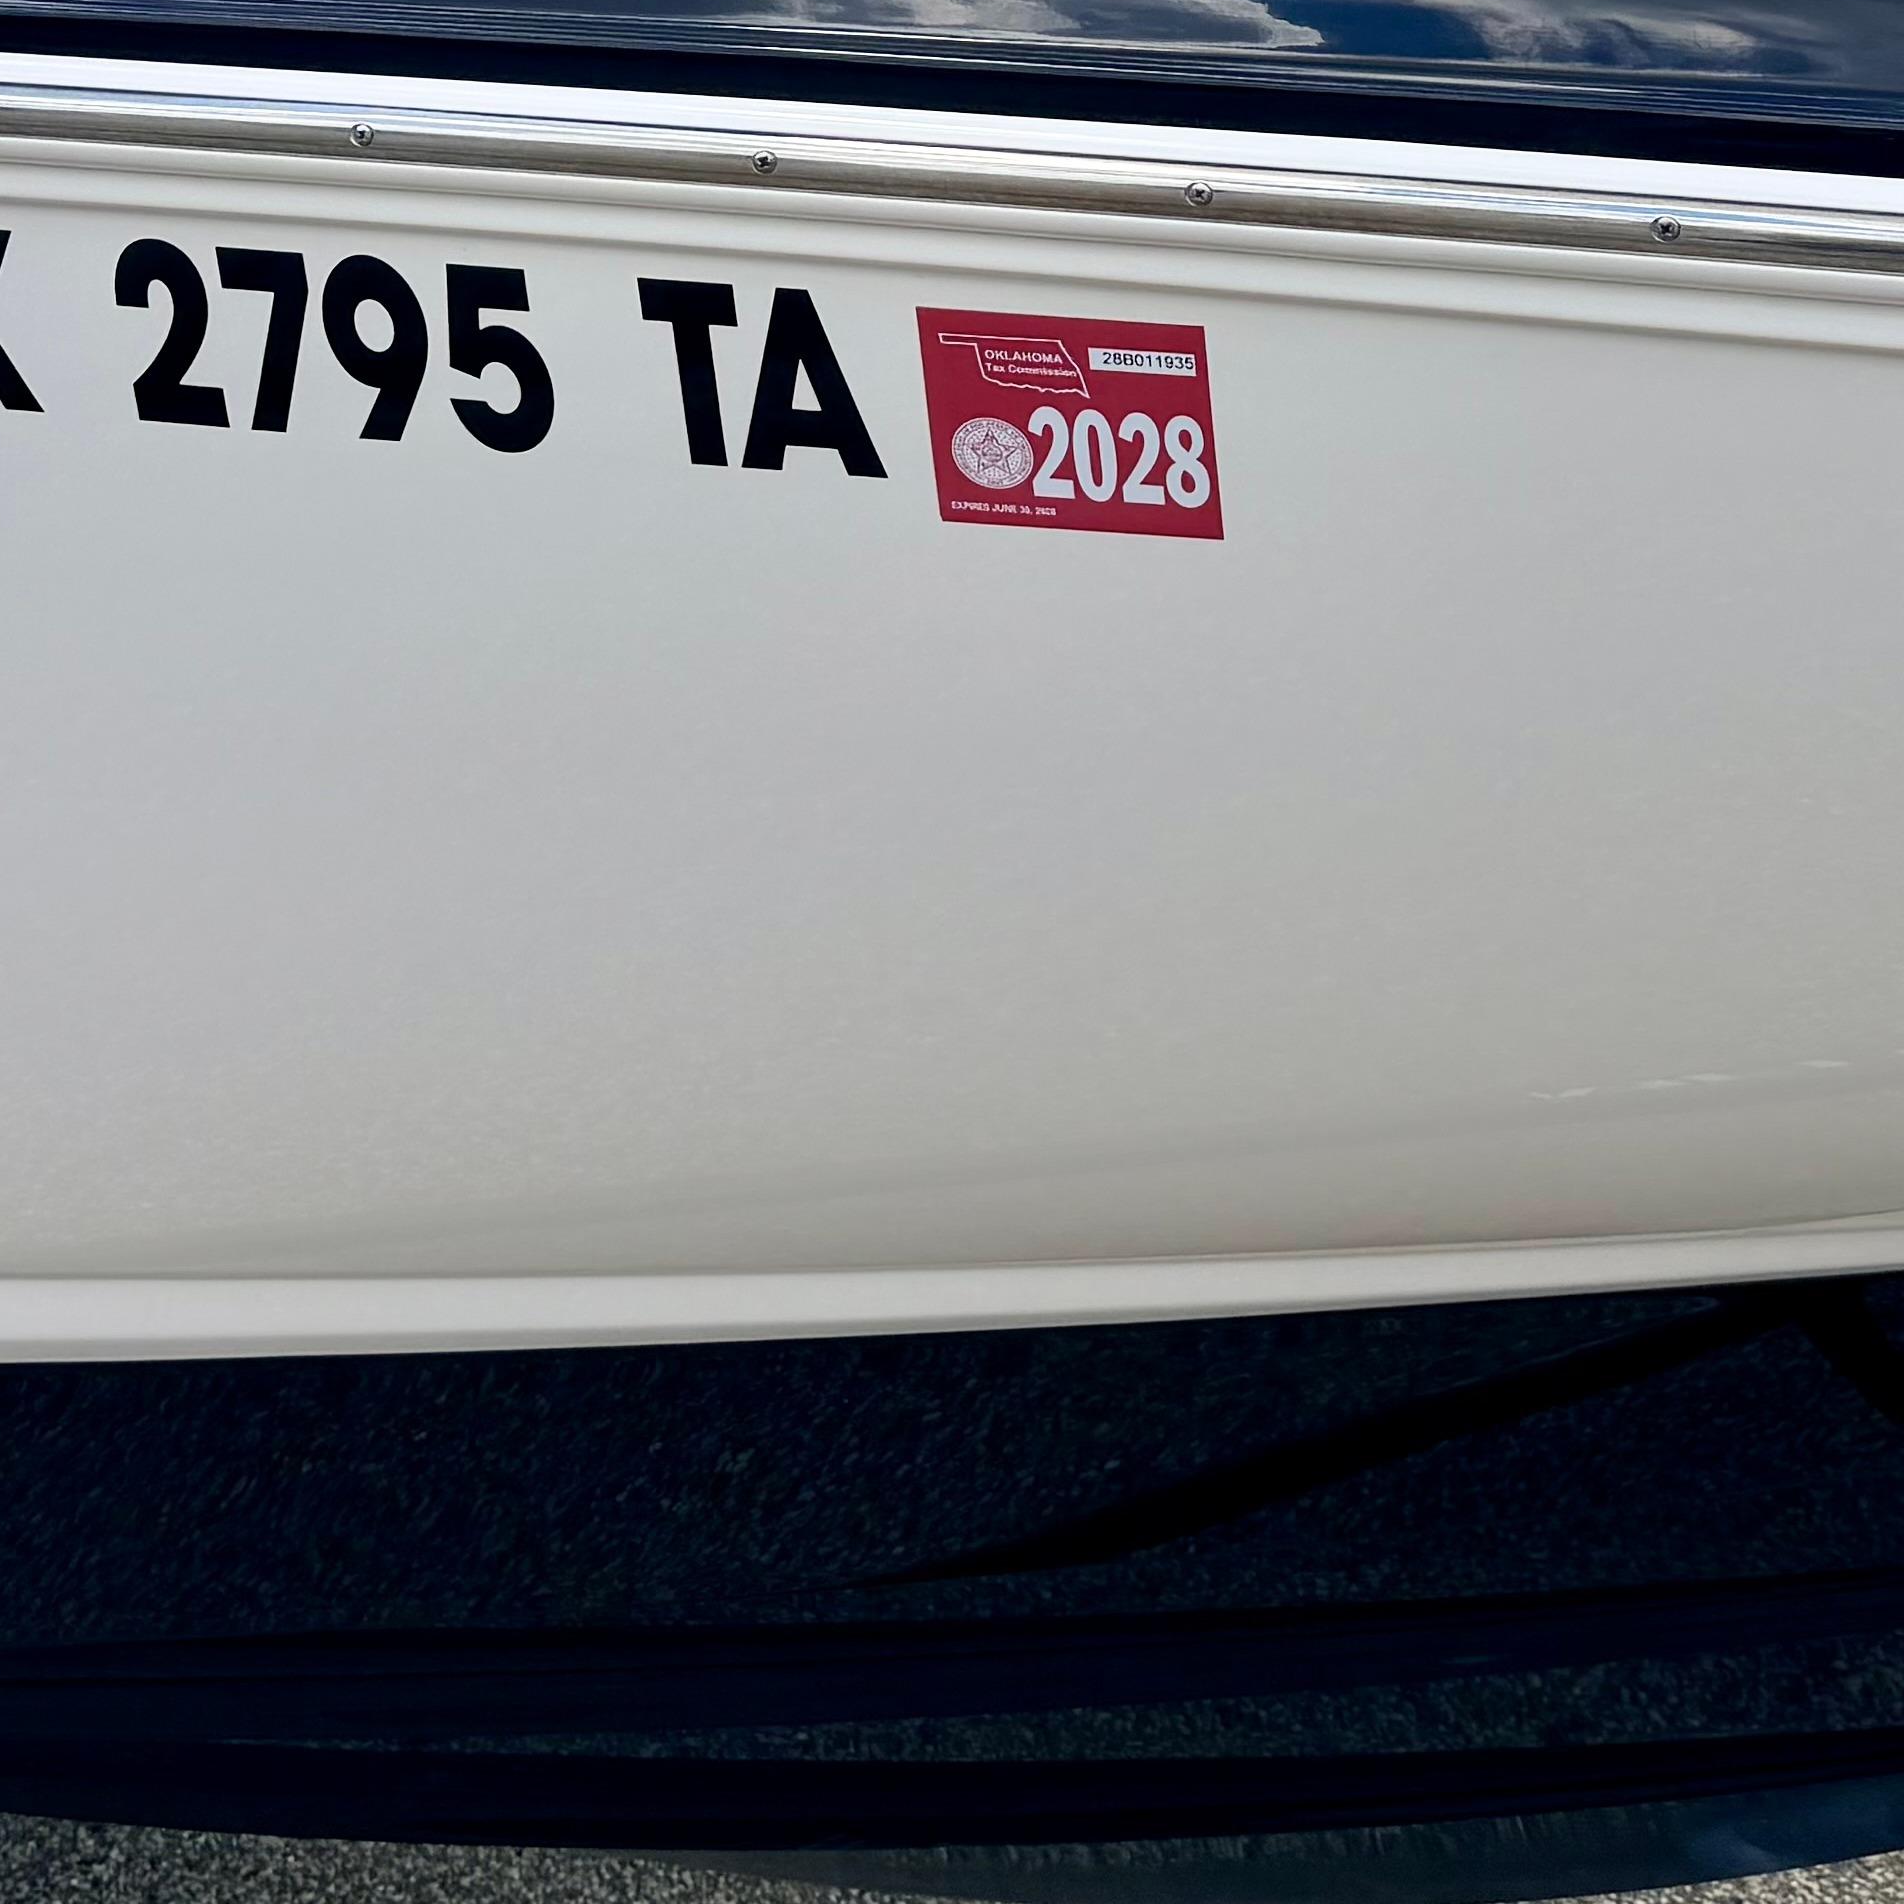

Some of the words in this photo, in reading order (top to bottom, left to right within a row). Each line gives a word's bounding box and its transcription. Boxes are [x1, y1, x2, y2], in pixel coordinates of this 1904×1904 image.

[114, 238, 555, 454] 2795
[636, 277, 889, 479] TA
[984, 349, 1064, 365] OKLAHOMA
[1102, 351, 1195, 370] 28B011935
[984, 362, 1006, 373] Tax
[1007, 363, 1077, 378] Commission
[1027, 406, 1211, 509] 2028
[951, 500, 990, 512] EXPIRES
